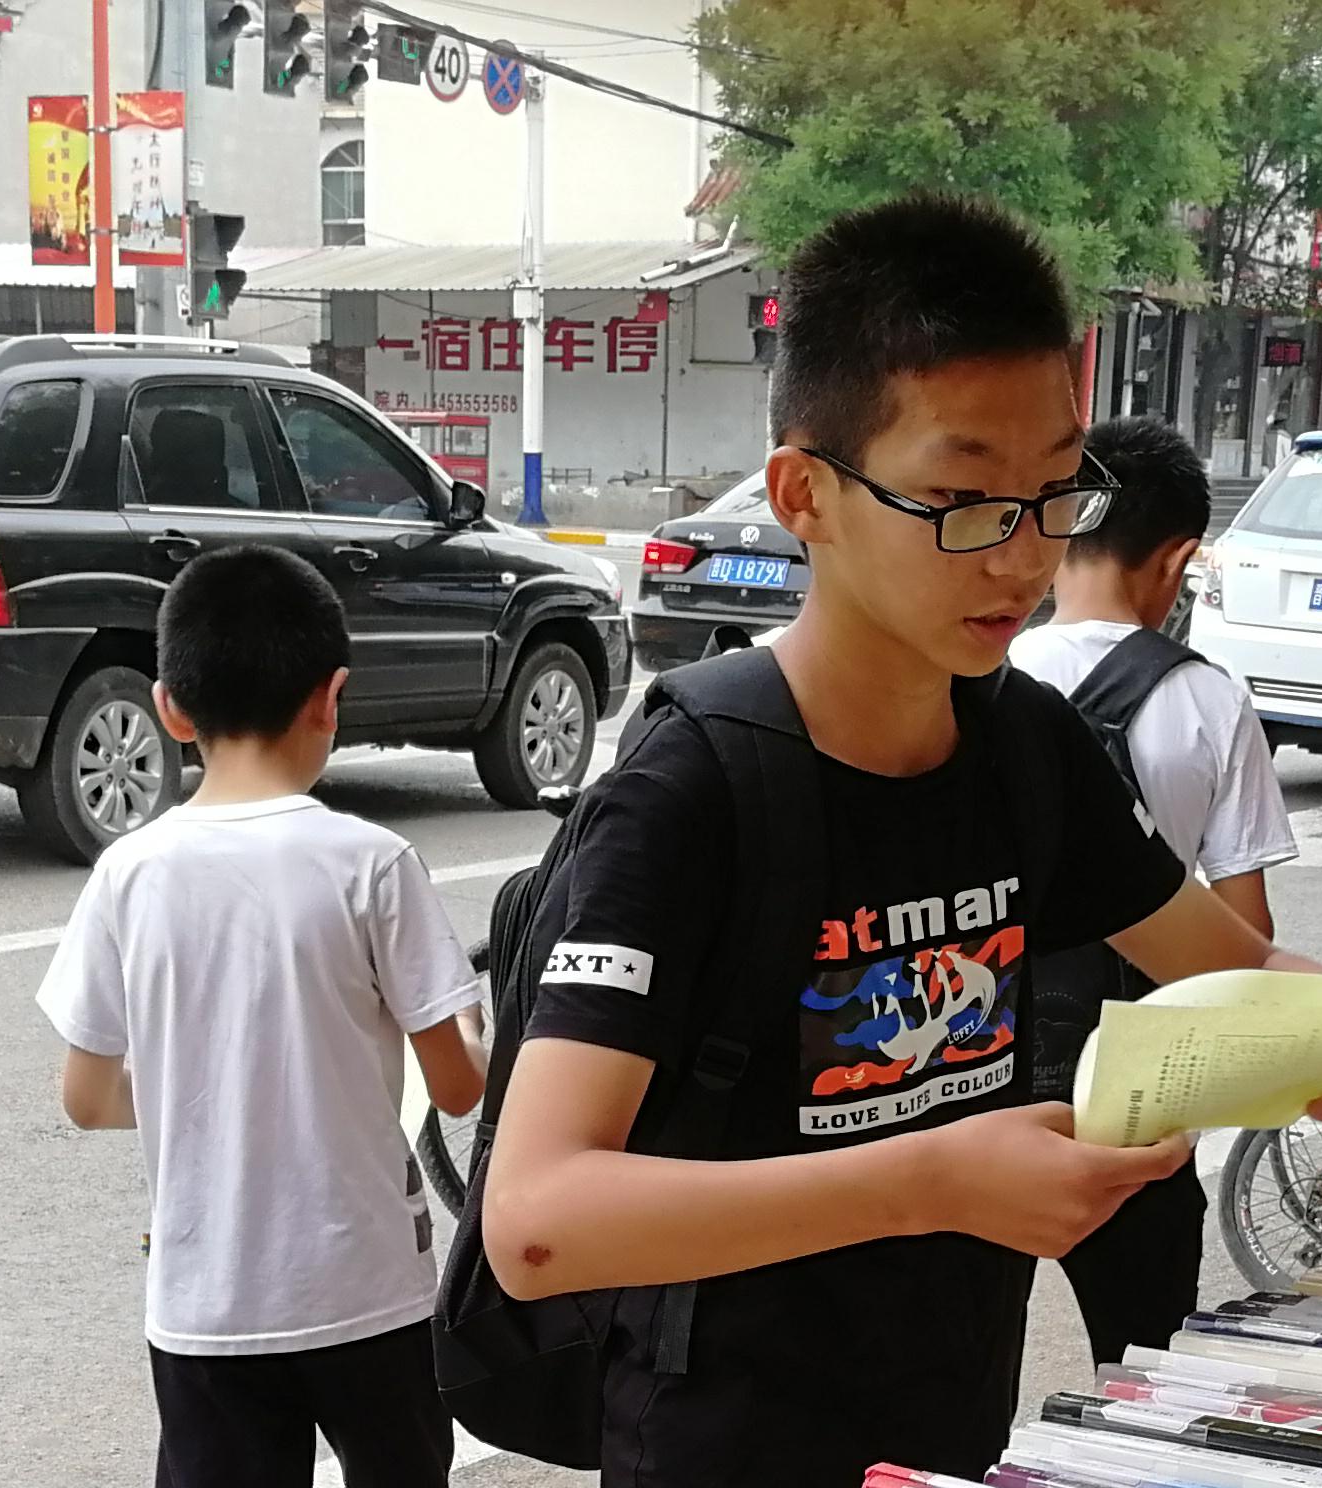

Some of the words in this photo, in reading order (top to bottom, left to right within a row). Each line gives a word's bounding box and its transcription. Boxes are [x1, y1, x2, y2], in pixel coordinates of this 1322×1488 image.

[435, 45, 461, 84] 40
[810, 1105, 879, 1130] LOVE
[895, 1087, 931, 1116] LIFE
[941, 1060, 1013, 1097] COLOUR
